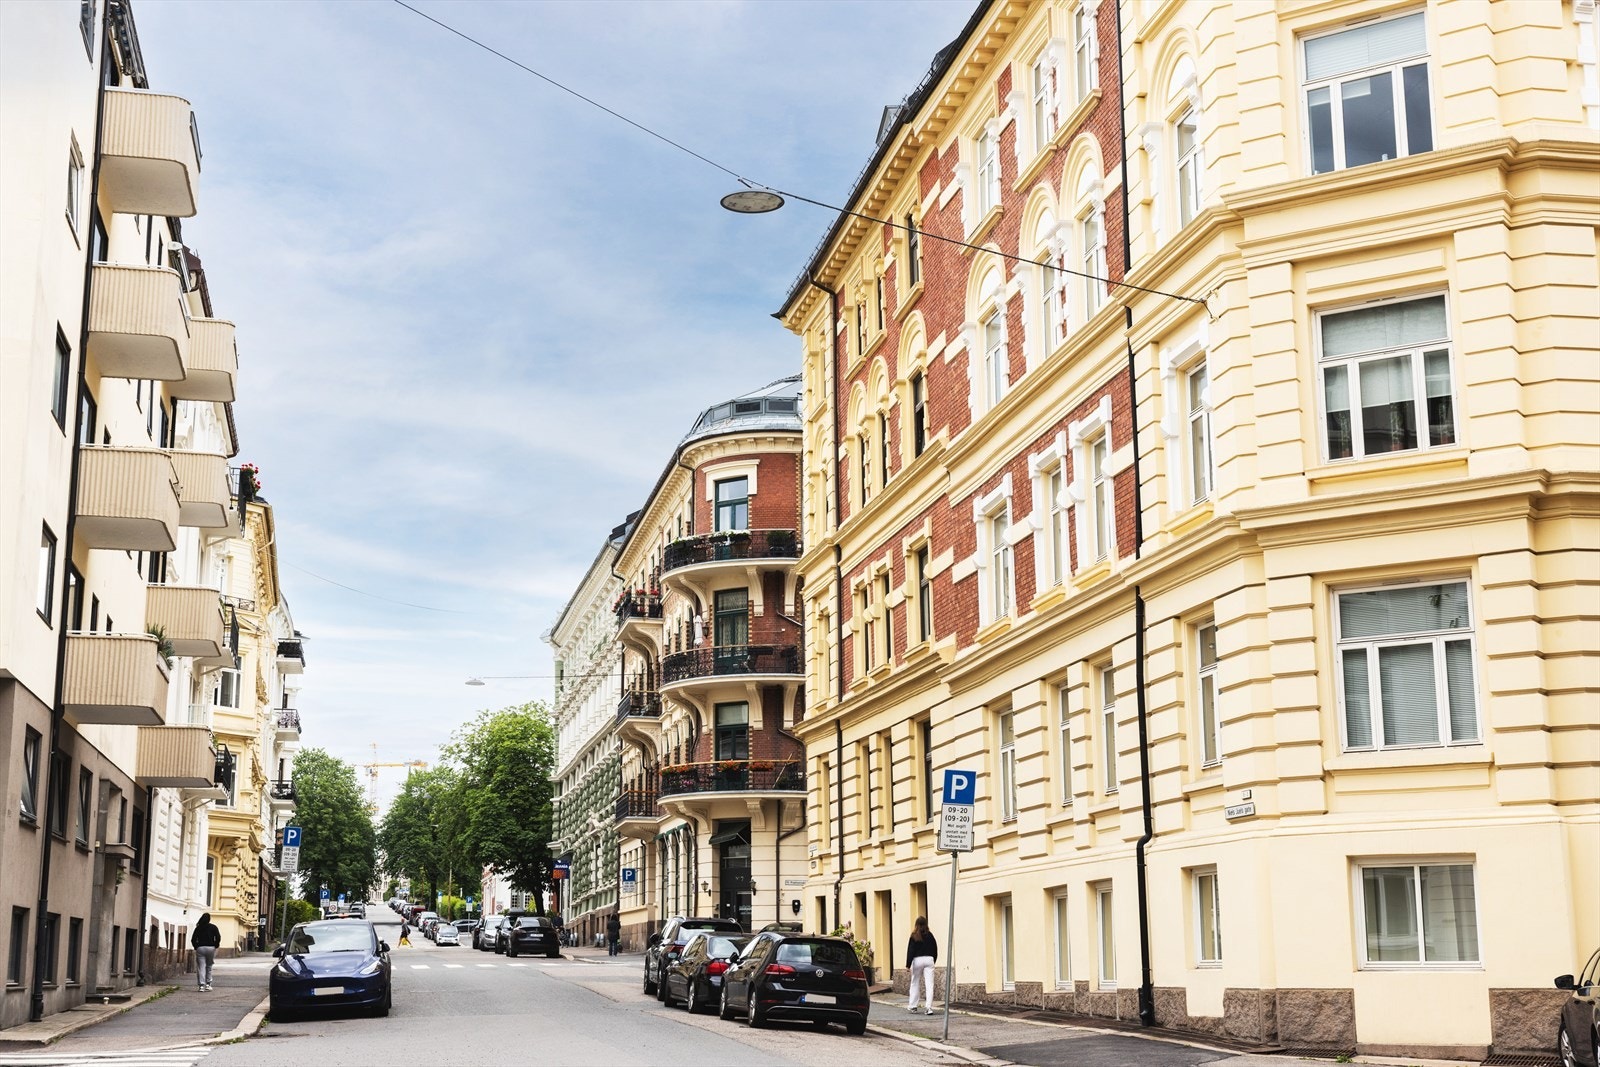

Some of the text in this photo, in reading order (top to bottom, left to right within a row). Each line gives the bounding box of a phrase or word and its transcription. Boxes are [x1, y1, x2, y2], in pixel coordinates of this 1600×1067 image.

[951, 774, 968, 800] P
[945, 815, 970, 823] (09-20)
[287, 829, 297, 844] P
[625, 870, 633, 880] P
